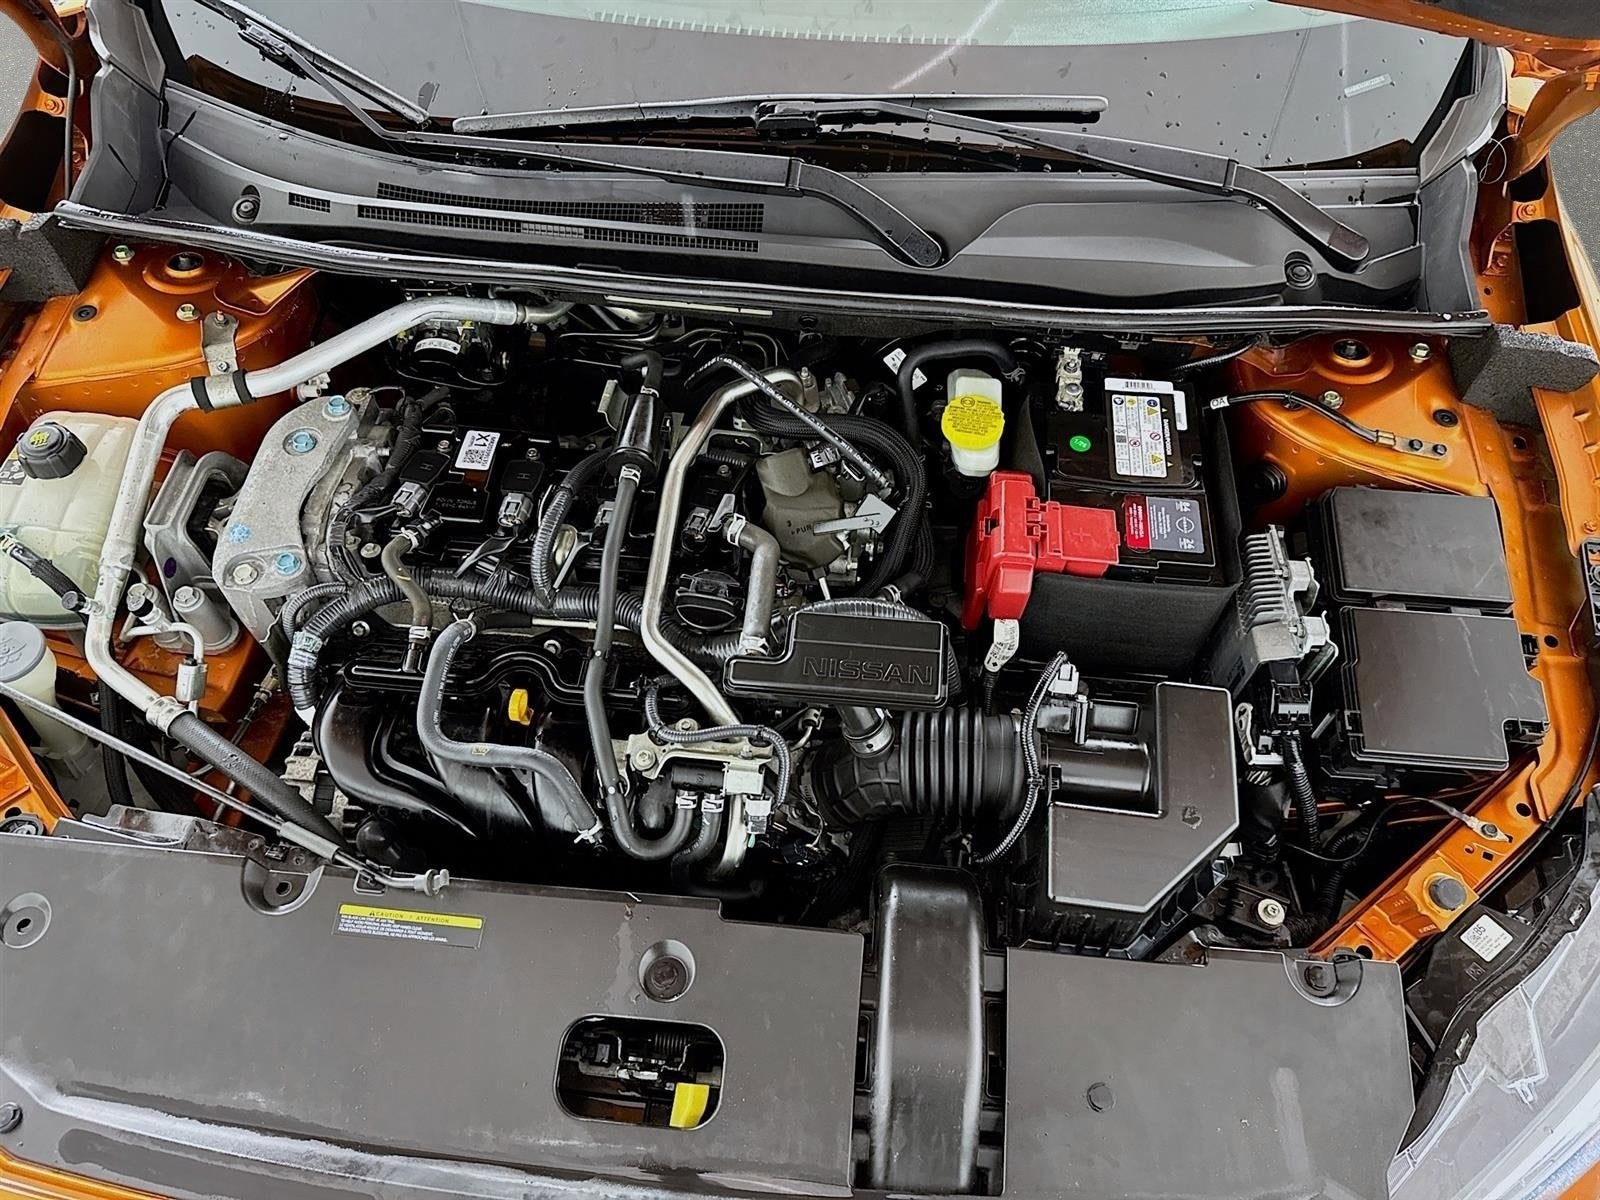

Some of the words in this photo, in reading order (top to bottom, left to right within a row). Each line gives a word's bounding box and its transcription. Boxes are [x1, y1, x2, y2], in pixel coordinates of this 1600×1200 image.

[474, 433, 490, 447] X1
[802, 656, 933, 685] NISSAN
[375, 911, 403, 919] CAUTION
[416, 914, 450, 923] ATTENTION
